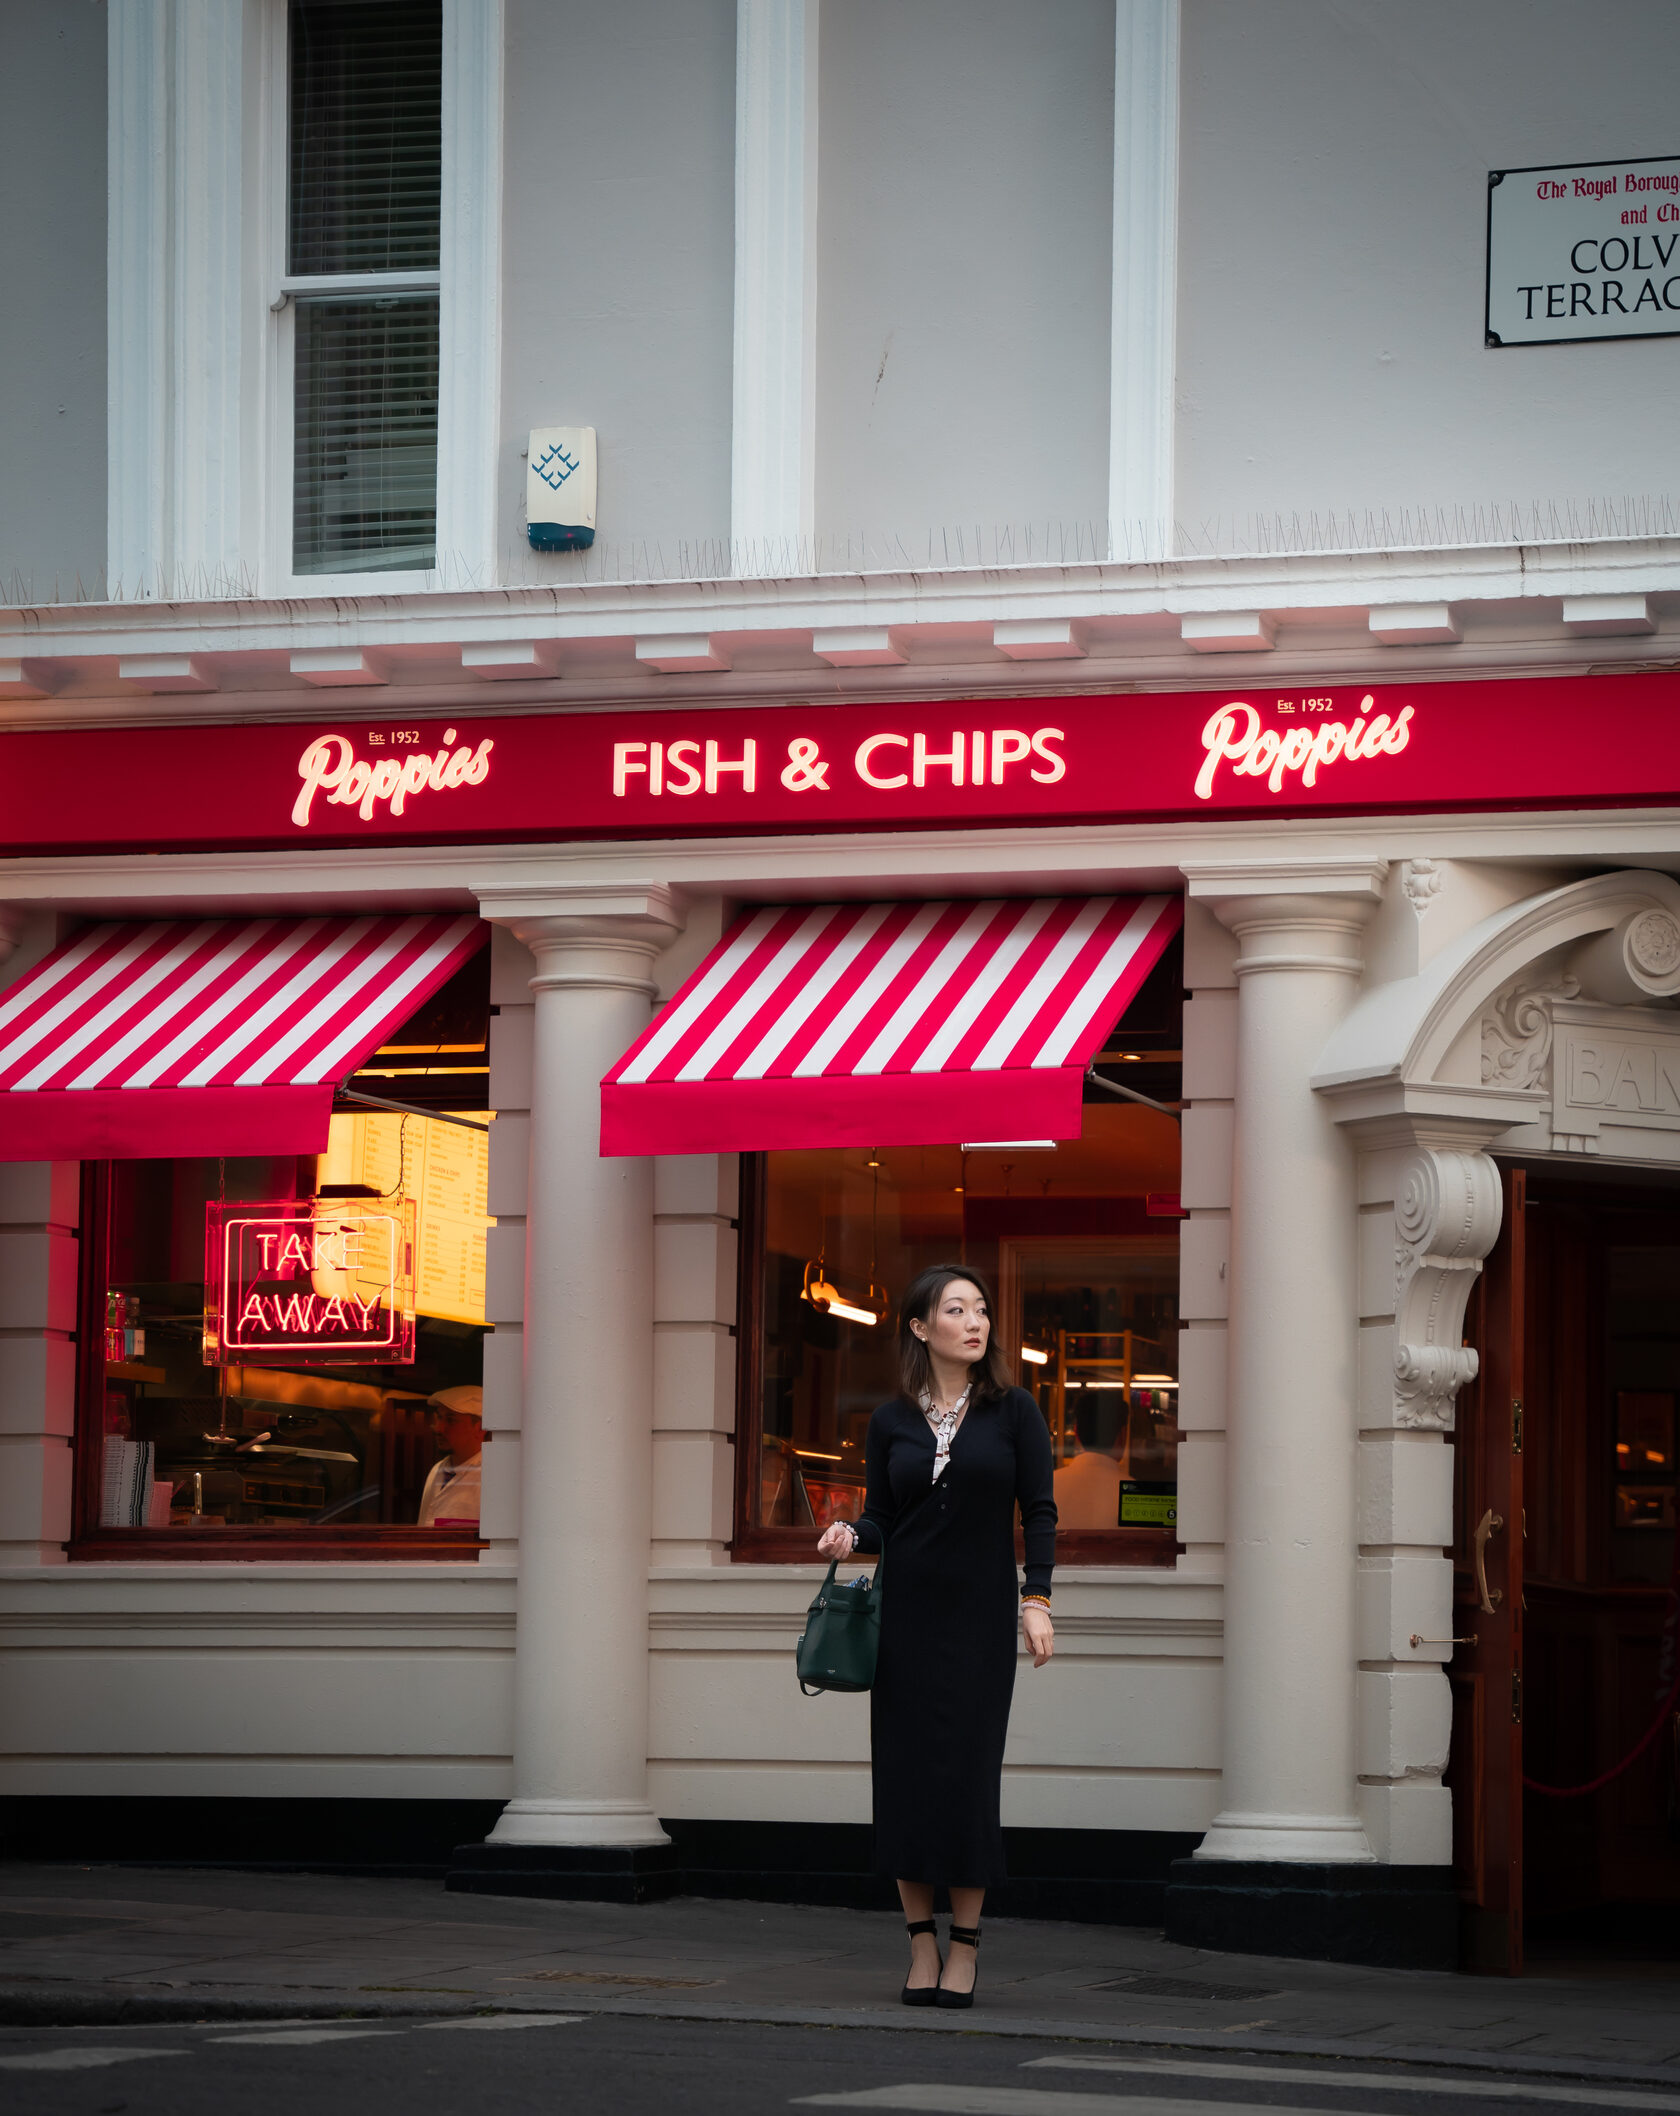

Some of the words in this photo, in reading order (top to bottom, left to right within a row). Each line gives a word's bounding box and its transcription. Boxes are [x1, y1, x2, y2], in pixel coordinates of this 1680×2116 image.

[1537, 181, 1567, 200] The
[1571, 176, 1617, 201] Royal
[1625, 174, 1680, 195] Boroug
[1620, 204, 1647, 224] and
[1571, 233, 1680, 274] COLV
[1301, 698, 1333, 712] 1952
[390, 731, 420, 744] 1952
[1194, 694, 1415, 799] Poppies
[291, 728, 494, 827] Poppies
[613, 738, 756, 797] FISH
[780, 737, 830, 792] &
[855, 727, 1066, 789] CHIPS
[256, 1232, 365, 1271] TAKE
[237, 1293, 381, 1332] AWAY
